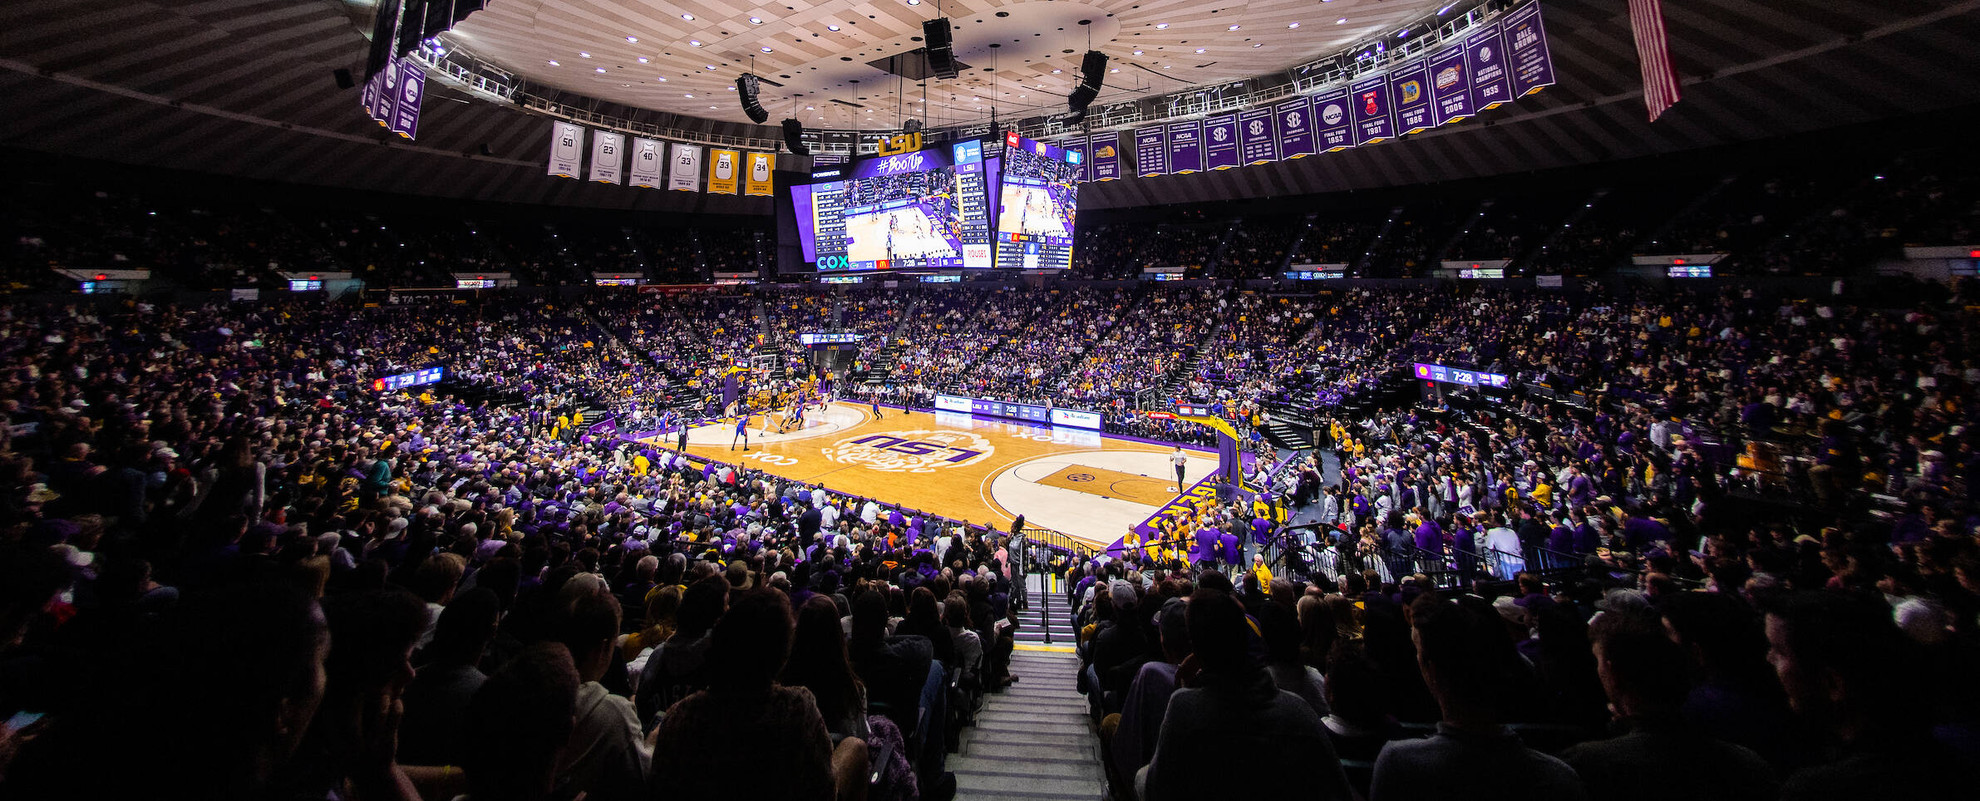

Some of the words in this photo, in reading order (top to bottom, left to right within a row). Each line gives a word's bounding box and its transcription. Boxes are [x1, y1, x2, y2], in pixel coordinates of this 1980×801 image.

[1483, 85, 1499, 97] 1935
[1445, 102, 1463, 114] 2006
[1249, 120, 1264, 135] SEC
[1213, 127, 1227, 141] SEC
[562, 138, 573, 147] 50
[878, 132, 923, 157] LSU
[603, 146, 613, 154] 23
[643, 152, 652, 160] 40
[681, 157, 690, 165] 33
[719, 161, 729, 169] 33
[816, 255, 848, 270] COX
[902, 259, 916, 267] 7:28
[1453, 371, 1473, 383] 7:28
[1006, 405, 1017, 413] 7:28
[850, 435, 983, 463] LSU
[742, 451, 798, 465] COX
